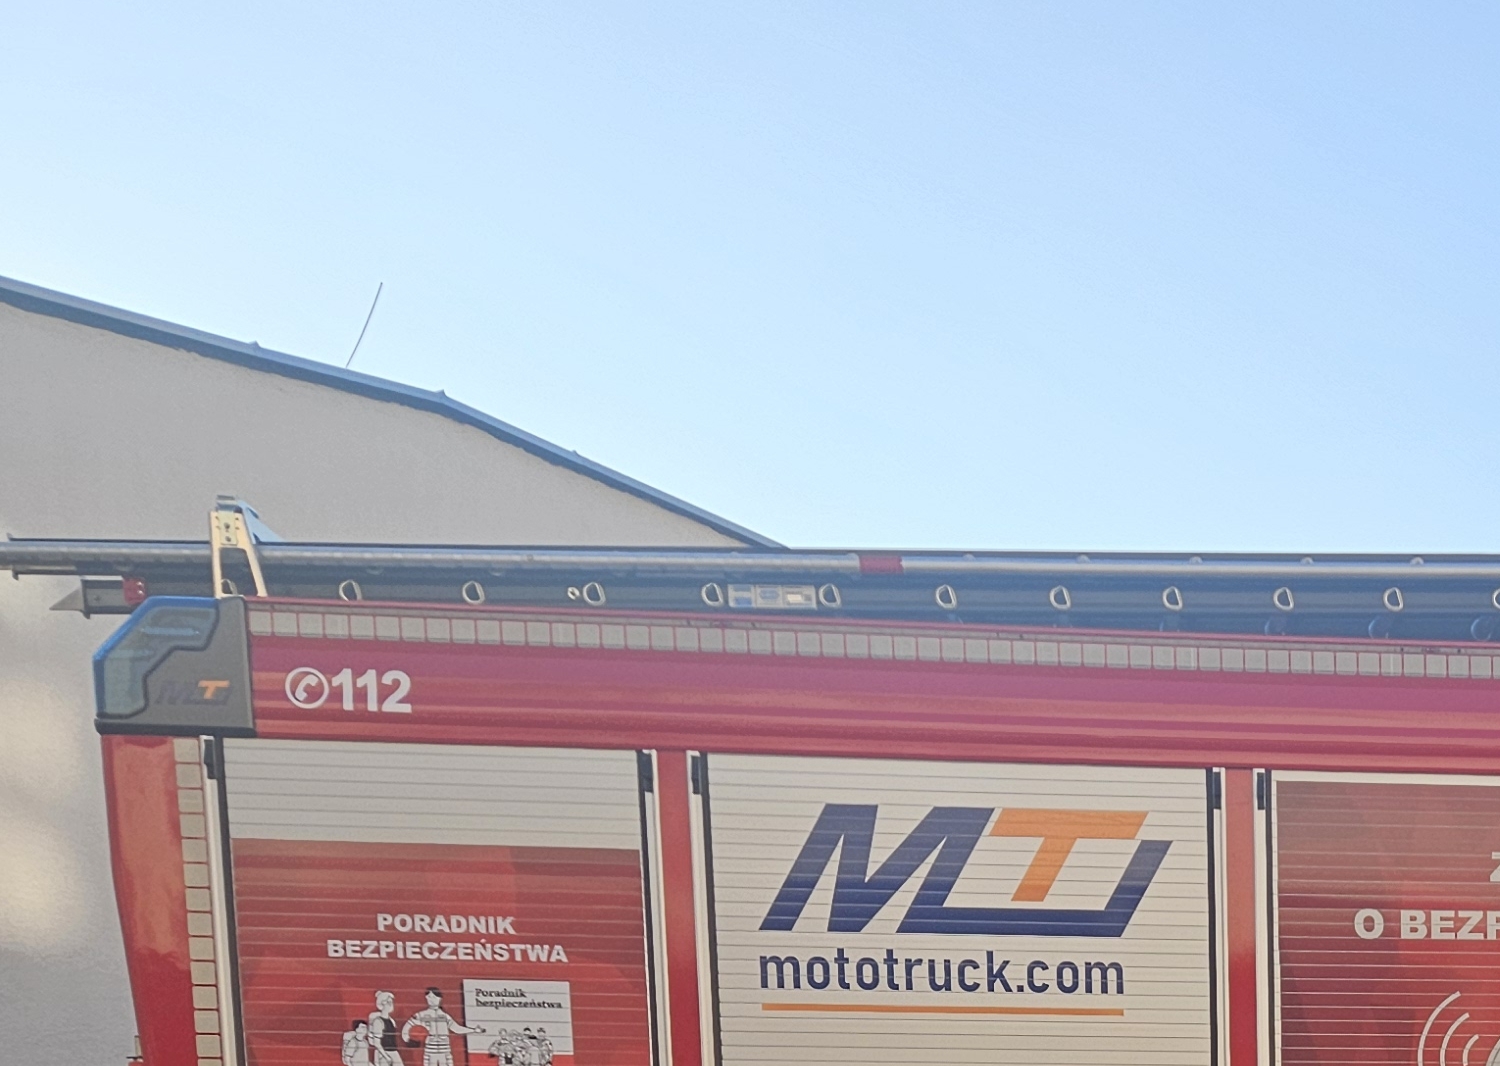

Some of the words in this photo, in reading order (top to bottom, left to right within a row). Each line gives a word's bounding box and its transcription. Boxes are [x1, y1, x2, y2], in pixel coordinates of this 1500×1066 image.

[331, 667, 413, 714] 112
[758, 803, 1173, 937] MT
[376, 912, 517, 936] PORADNIK
[1353, 908, 1385, 941] O
[326, 938, 569, 964] BEZPIECZEŃSTWA
[759, 946, 1126, 995] mototruck.com
[475, 988, 528, 998] Poradnik
[475, 998, 563, 1010] bezpieczeństwa
